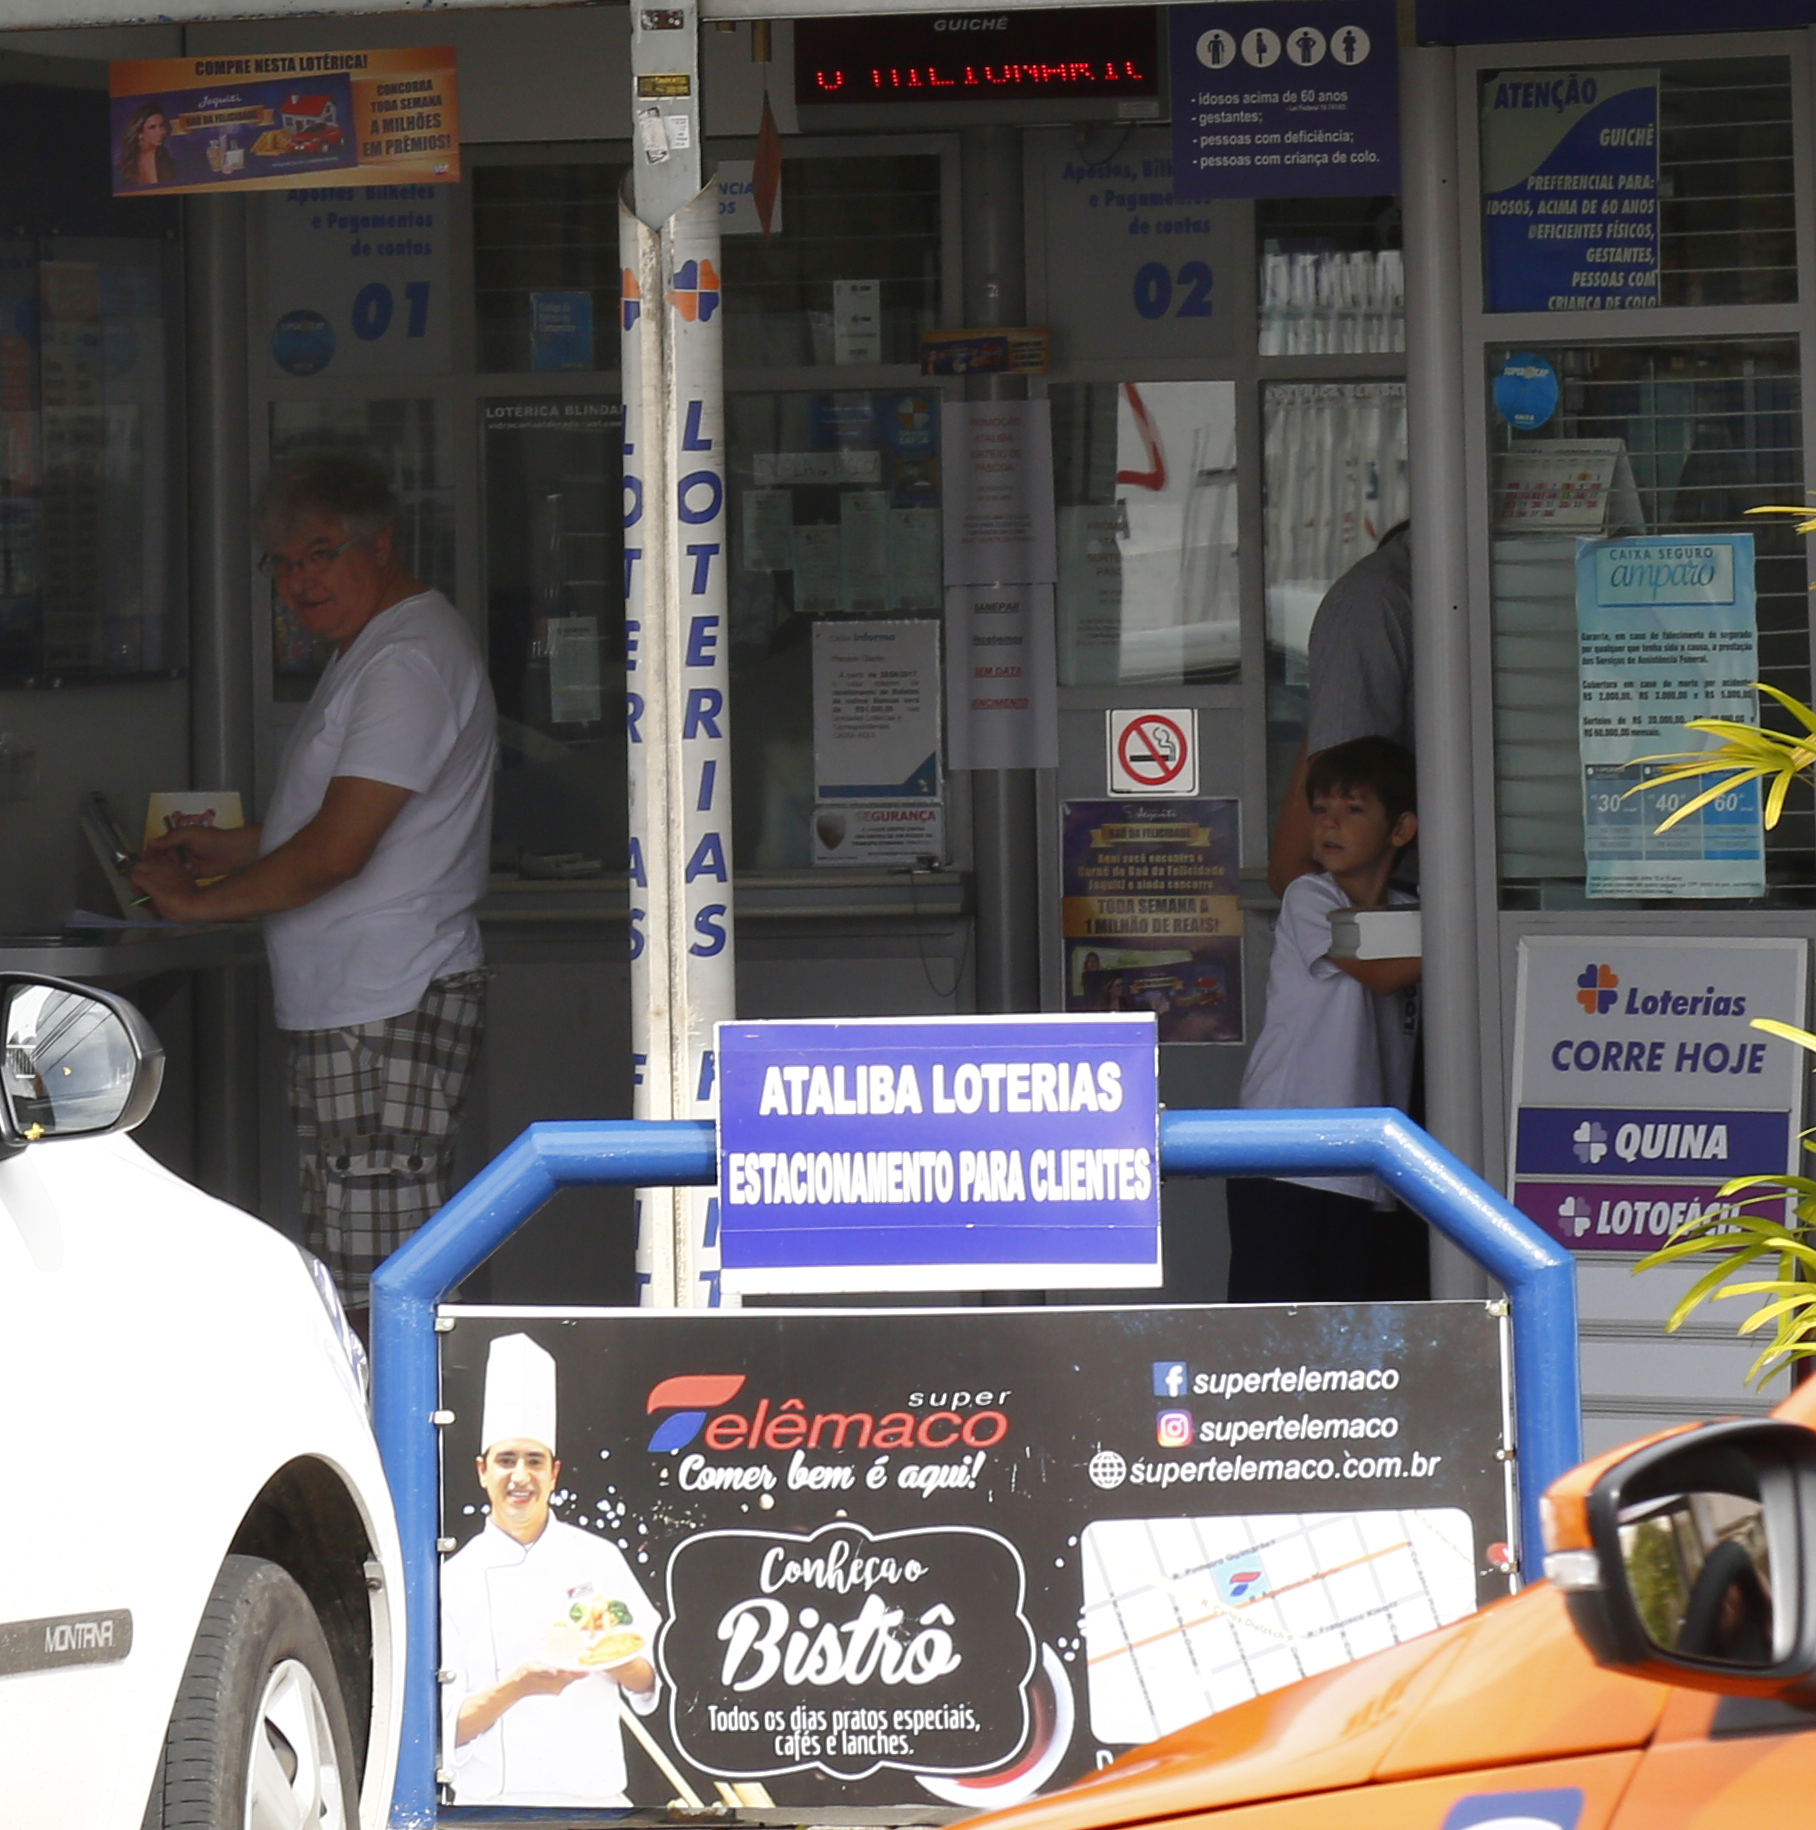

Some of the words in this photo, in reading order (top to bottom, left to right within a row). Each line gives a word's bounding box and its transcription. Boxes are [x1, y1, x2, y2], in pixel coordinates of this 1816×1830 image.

[932, 15, 1009, 32] GUICHÊ
[195, 58, 252, 77] COMPRE
[255, 56, 296, 74] NESTA
[299, 53, 368, 72] LOTÉRICA!
[377, 79, 434, 97] CONCORRA
[1198, 91, 1240, 106] idosos
[1242, 90, 1279, 104] acima
[1283, 89, 1298, 103] de
[1300, 89, 1315, 103] 60
[1318, 90, 1349, 103] anos
[1493, 73, 1598, 114] ATENÇÃO
[197, 92, 243, 110] Jequiti
[370, 98, 399, 113] TODA
[400, 94, 443, 111] SEMANA
[1198, 110, 1263, 127] gestantes;
[363, 140, 383, 158] EM
[385, 133, 452, 155] PRÊMIOS!
[1200, 133, 1252, 149] pessoas
[1254, 132, 1281, 145] com
[1284, 128, 1355, 144] deficiência;
[1599, 123, 1655, 147] GUICHÊ
[1200, 154, 1251, 170] pessoas
[1254, 153, 1281, 166] com
[1284, 151, 1329, 167] criança
[1331, 150, 1346, 163] de
[1350, 150, 1381, 163] colo.
[1527, 174, 1615, 191] PREFERENCIAL
[1617, 174, 1655, 190] PARA:
[1088, 193, 1100, 208] e
[1486, 199, 1534, 217] IDOSOS,
[1537, 199, 1578, 215] ACIMA
[1581, 199, 1598, 214] DE
[1601, 199, 1618, 214] 60
[1622, 198, 1655, 214] ANOS
[311, 213, 323, 230] e
[326, 210, 434, 235] Pagamentos
[1128, 216, 1151, 235] de
[1155, 217, 1212, 235] contas
[1528, 223, 1603, 240] DEFICIENTES
[1606, 220, 1655, 241] FÍSICOS,
[350, 239, 372, 258] de
[376, 239, 433, 258] contas
[1586, 247, 1655, 265] GESTANTES,
[1133, 260, 1214, 320] 02
[1571, 271, 1625, 288] PESSOAS
[1628, 270, 1656, 287] COM
[350, 280, 432, 343] 01
[1605, 296, 1620, 310] DE
[1625, 295, 1656, 309] COLO
[484, 402, 561, 420] LOTÉRICA
[1608, 548, 1653, 561] CAIXA
[1658, 546, 1715, 560] SEGURO
[1609, 560, 1717, 602] amparo
[678, 400, 728, 959] LOTERIAS
[995, 666, 1023, 678] DATA
[1597, 793, 1621, 813] 30
[1654, 792, 1680, 813] 40
[1713, 792, 1739, 813] 60
[1097, 898, 1136, 915] TODA
[1138, 897, 1196, 914] SEMANA
[1200, 898, 1210, 913] A
[1094, 916, 1148, 935] MILHÃO
[1152, 919, 1170, 934] DE
[1624, 985, 1747, 1018] Loterias
[1551, 1039, 1666, 1072] CORRE
[1674, 1041, 1768, 1075] HOJE
[757, 1063, 924, 1117] ATALIBA
[931, 1060, 1124, 1115] LOTERIAS
[1613, 1122, 1729, 1164] QUINA
[727, 1149, 955, 1206] ESTACIONAMENTO
[958, 1149, 1027, 1204] PARA
[1029, 1147, 1152, 1203] CLIENTES
[1595, 1195, 1743, 1237] LOTOFÁCIL
[1192, 1365, 1400, 1401] supertelemaco
[907, 1389, 1013, 1412] super
[1198, 1413, 1400, 1448] supertelemaco
[677, 1452, 778, 1491] Comer
[786, 1448, 855, 1491] bem
[865, 1455, 890, 1490] é
[897, 1449, 987, 1499] aqui!
[1129, 1451, 1442, 1490] supertelemaco.com.br
[759, 1540, 902, 1594] Conheça
[43, 1618, 115, 1654] MONTANA
[716, 1593, 963, 1692] Bistrô
[707, 1704, 760, 1733] Todos
[764, 1711, 786, 1732] os
[789, 1705, 828, 1733] dias
[832, 1707, 889, 1737] pratos
[892, 1703, 981, 1736] especiais,
[774, 1732, 821, 1762] cafés
[826, 1739, 837, 1757] e
[840, 1731, 915, 1757] lanches.
